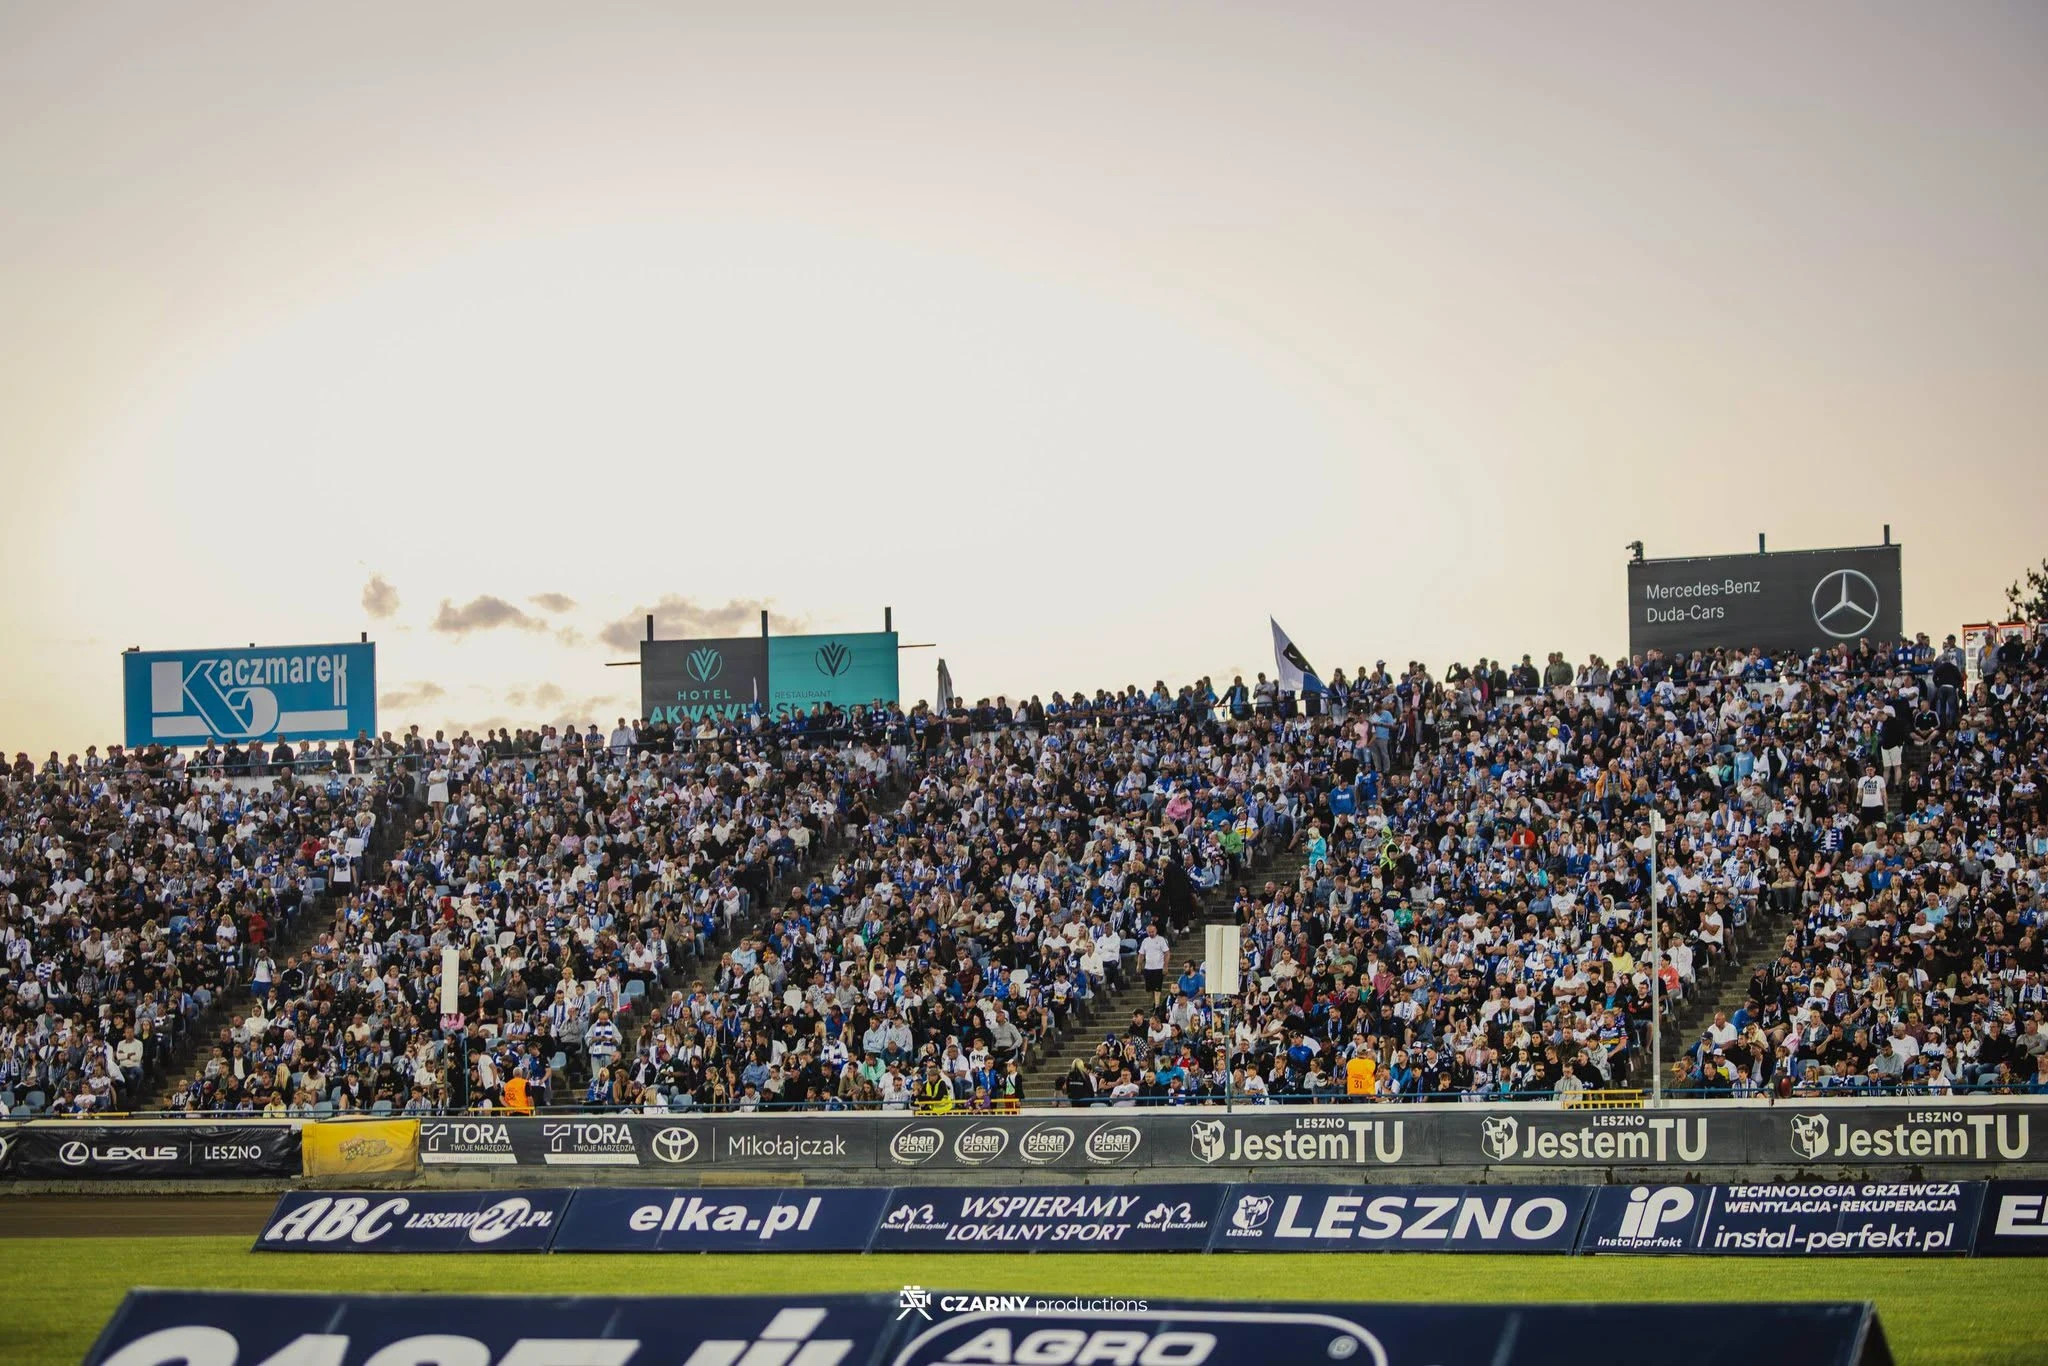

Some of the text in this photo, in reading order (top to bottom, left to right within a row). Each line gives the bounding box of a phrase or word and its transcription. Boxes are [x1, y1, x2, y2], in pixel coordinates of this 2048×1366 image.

[1646, 579, 1761, 600] Mercedes-Benz
[1647, 605, 1725, 623] Duda-Cars
[677, 689, 732, 701] HOTEL
[775, 690, 832, 700] RESTAURANT
[1354, 1079, 1363, 1089] 31
[1296, 1118, 1346, 1129] LESZNO
[1592, 1115, 1645, 1127] LESZNO
[1908, 1111, 1963, 1123] LESZNO
[450, 1124, 511, 1144] TORA
[573, 1124, 633, 1144] TORA
[899, 1133, 935, 1145] clean
[963, 1132, 999, 1144] clean
[1028, 1132, 1065, 1144] clean
[1094, 1131, 1131, 1143] clean
[1522, 1117, 1708, 1162] JestemTU
[1834, 1114, 2030, 1160] JestemTU
[451, 1144, 473, 1152] TWOJE
[728, 1134, 847, 1161] Mikołajczak
[899, 1144, 934, 1153] ZONE
[963, 1143, 998, 1152] ZONE
[1028, 1143, 1064, 1152] ZONE
[1094, 1142, 1130, 1151] ZONE
[1229, 1120, 1404, 1164] JestemTU
[92, 1146, 178, 1161] LEXUS
[204, 1145, 262, 1160] LESZNO
[1729, 1184, 1961, 1199] TECHNOLOGIA GRZEWCZA
[960, 1195, 1140, 1217] WSPIERAMY
[265, 1197, 410, 1243] ABC
[629, 1197, 822, 1239] elka.pl
[1274, 1195, 1568, 1241] LESZNO
[945, 1224, 1131, 1241] LOKALNY SPORT
[1226, 1228, 1263, 1237] LESZNO
[1714, 1223, 1955, 1253] instal-perfekt.pl
[944, 1328, 1218, 1366] AGRO
